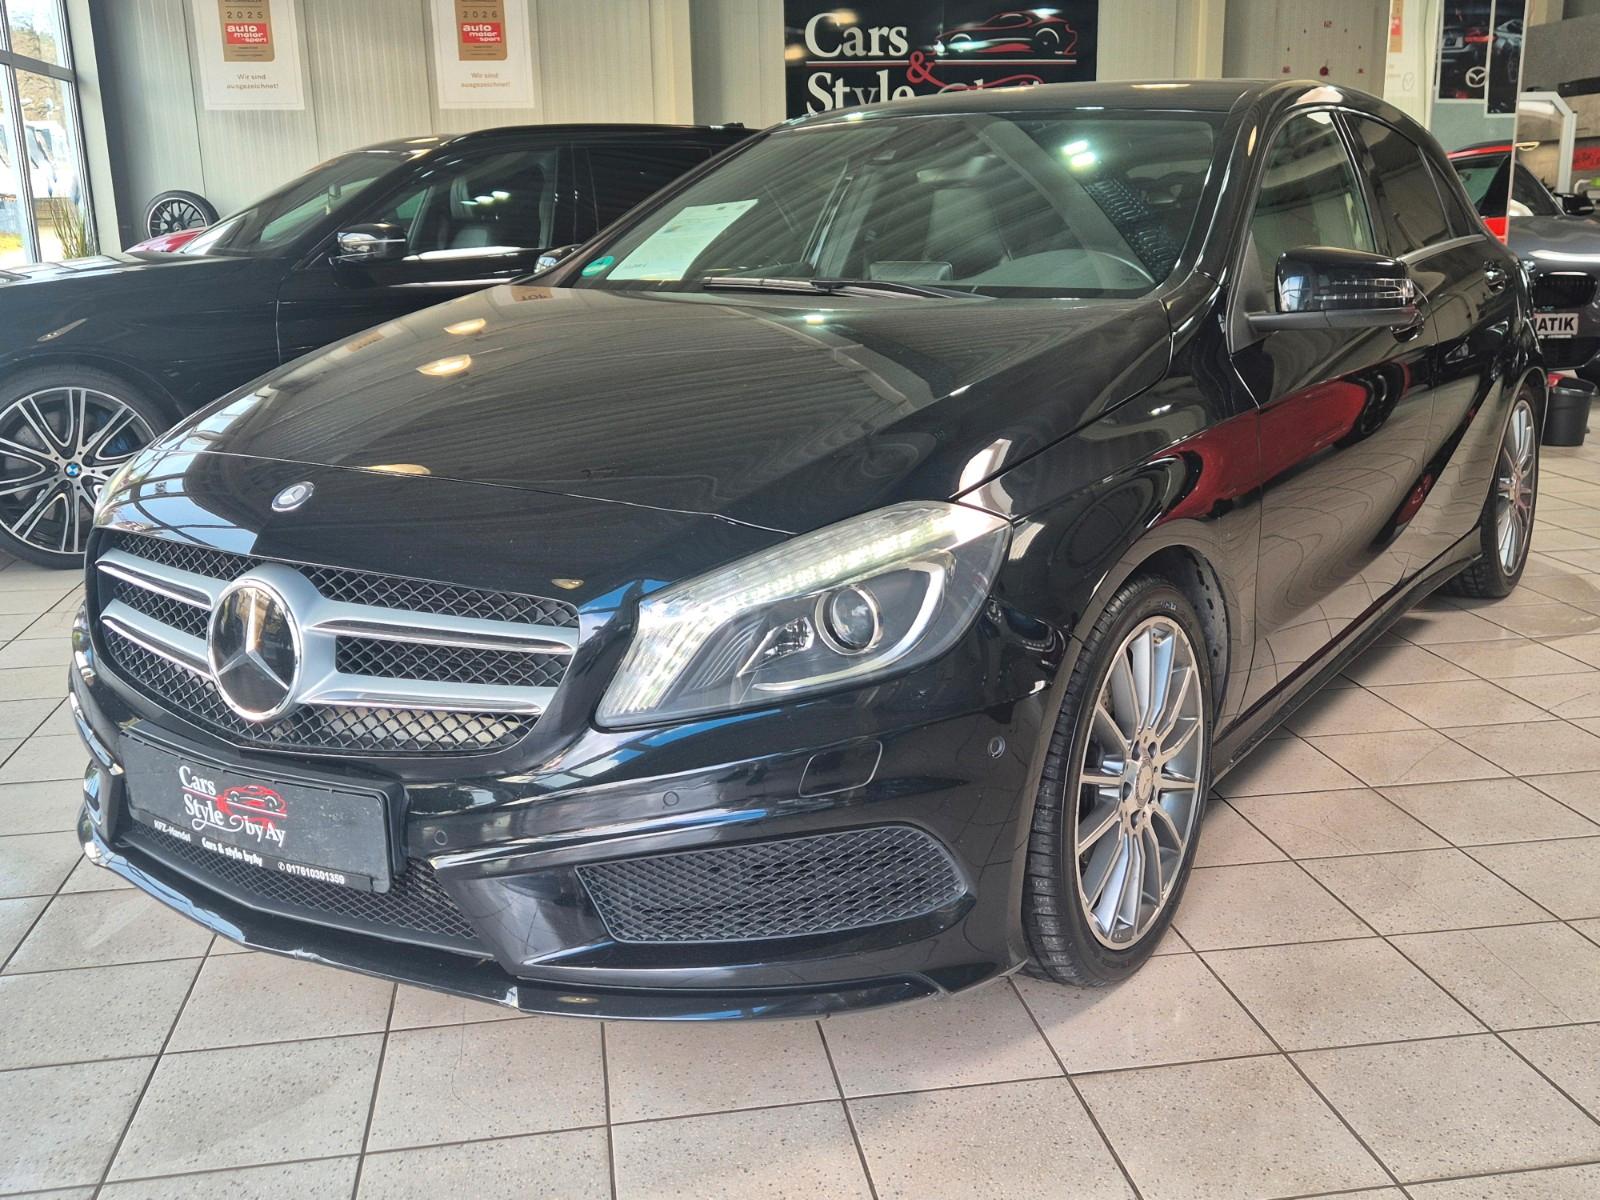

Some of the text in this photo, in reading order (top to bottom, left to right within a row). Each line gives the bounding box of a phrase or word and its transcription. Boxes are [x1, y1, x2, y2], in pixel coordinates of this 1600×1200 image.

[226, 11, 264, 19] 2025
[463, 10, 498, 18] 2026
[226, 24, 258, 32] auto
[462, 24, 492, 32] auto
[805, 13, 907, 57] Cars
[179, 766, 216, 795] Cars
[183, 793, 286, 848] Style by Ay
[202, 837, 216, 851] Cars
[217, 842, 226, 855] &
